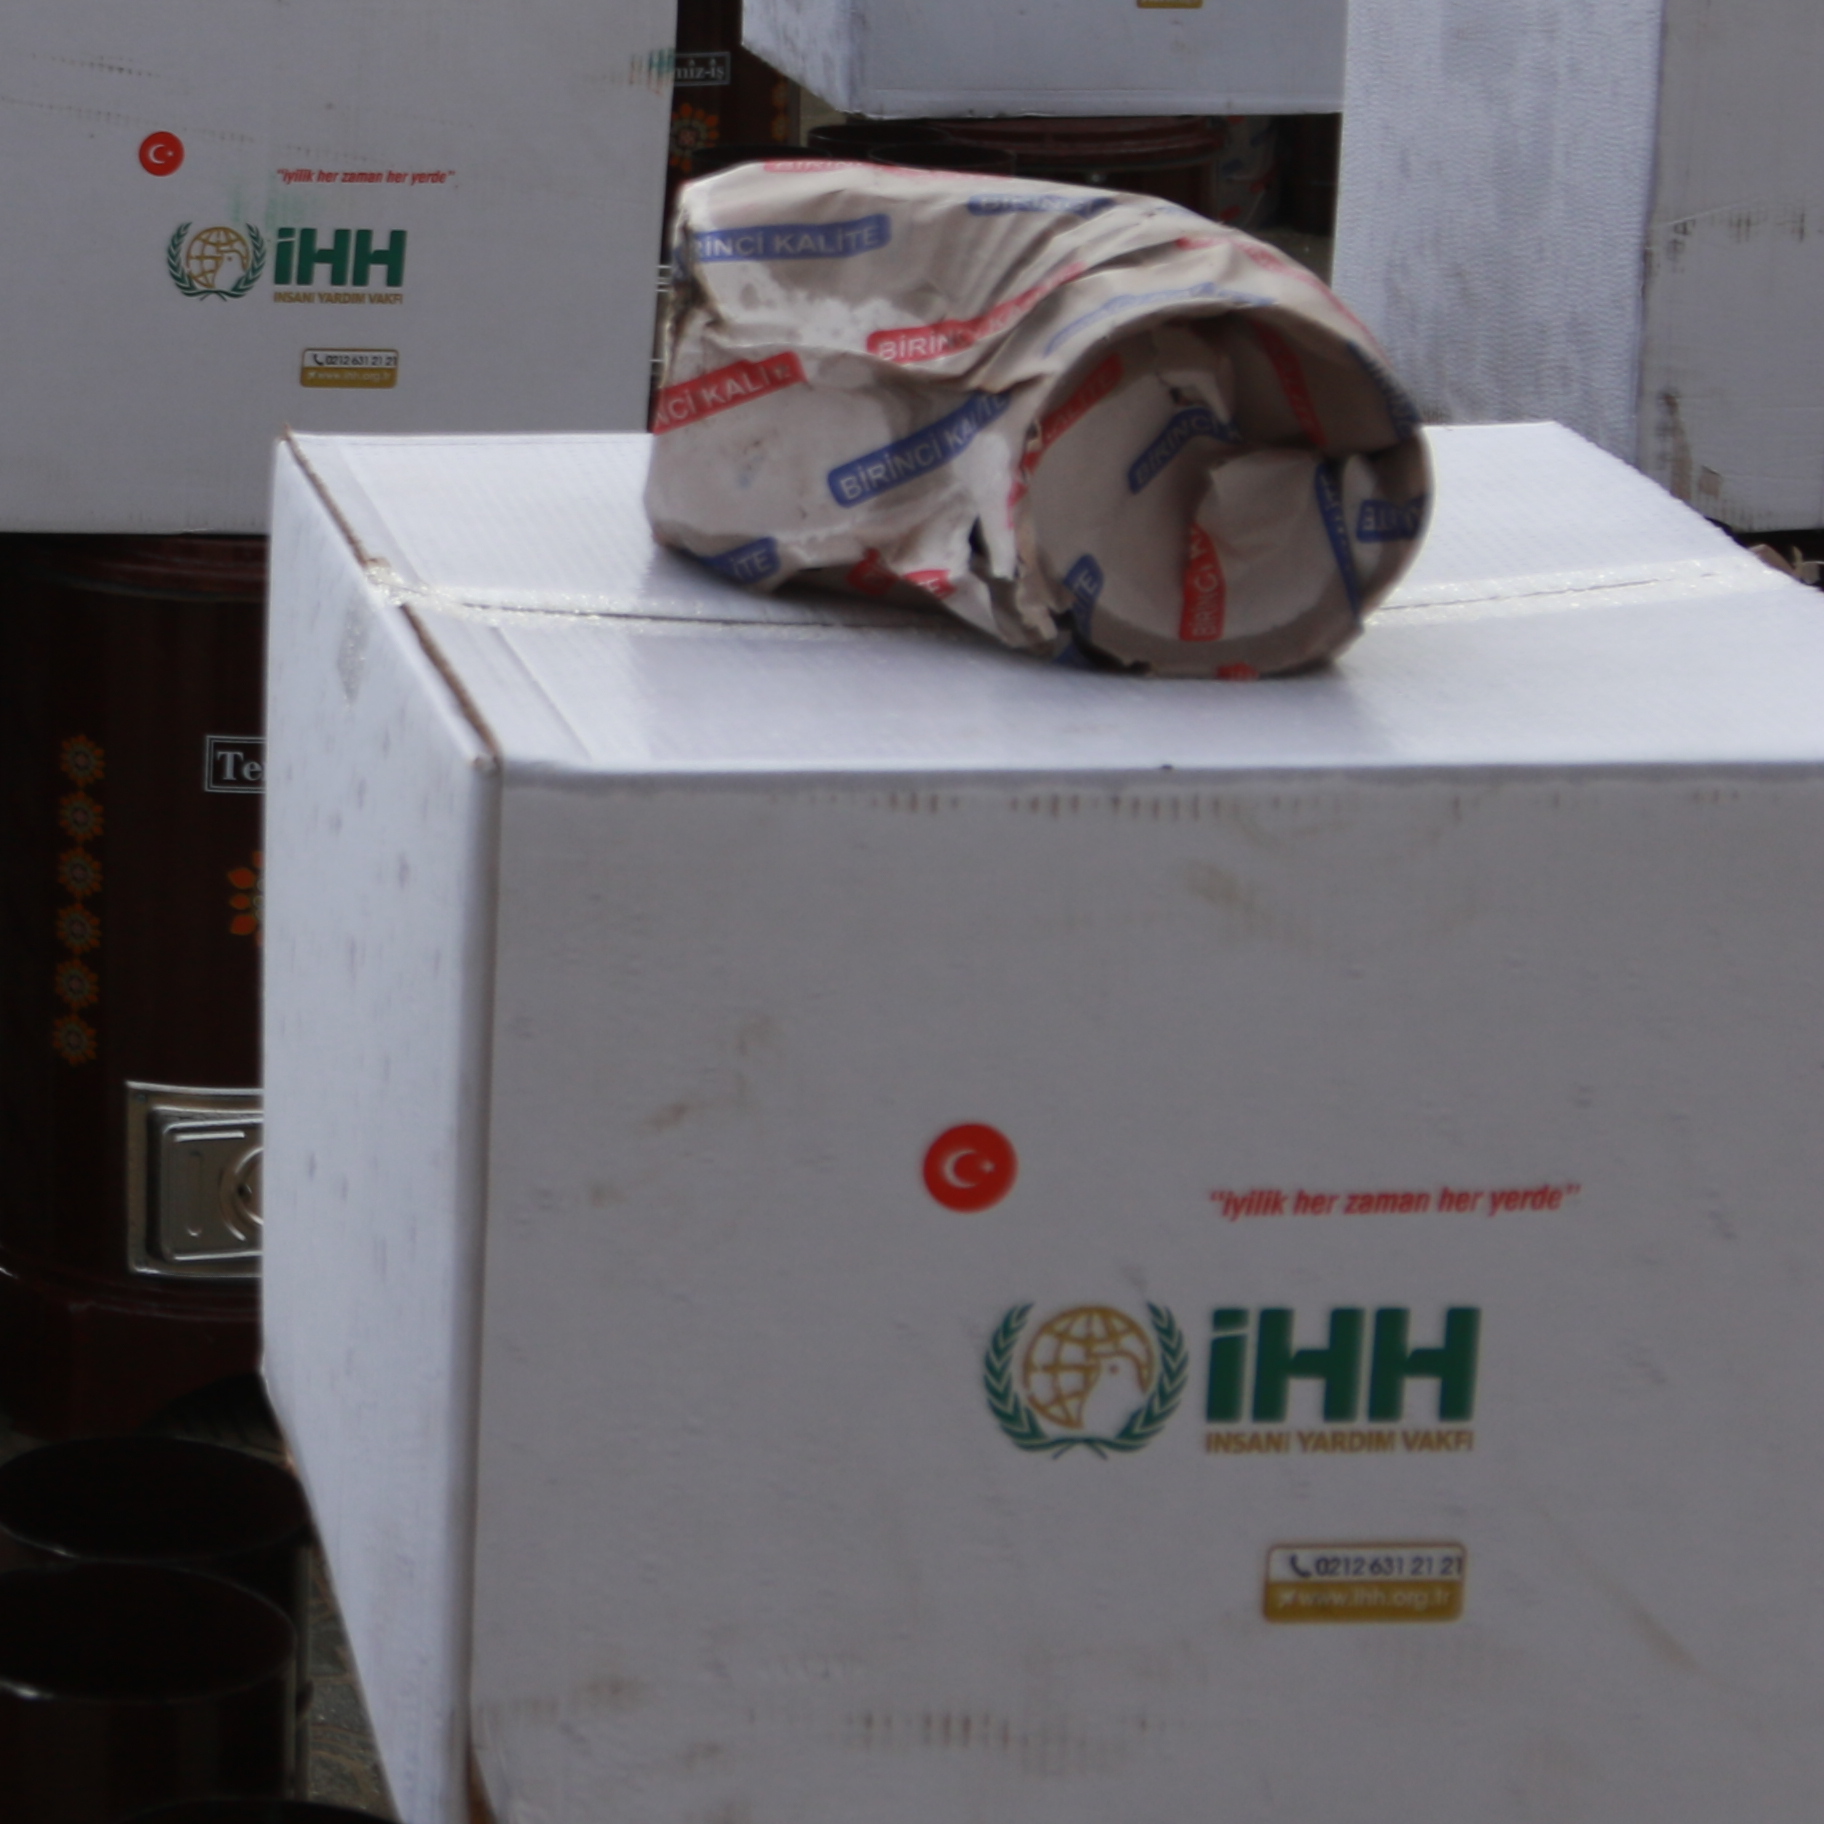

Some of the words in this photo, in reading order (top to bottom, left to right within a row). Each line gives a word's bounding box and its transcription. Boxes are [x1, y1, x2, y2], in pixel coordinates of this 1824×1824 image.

[317, 169, 339, 183] her
[342, 171, 382, 184] zaman
[387, 170, 408, 184] her
[774, 225, 881, 253] KALİTE
[838, 440, 942, 501] BİRİNCİ
[1292, 1190, 1337, 1216] her
[1344, 1192, 1428, 1215] zaman
[1438, 1188, 1480, 1214] her
[1298, 1431, 1394, 1454] YARDIM
[1402, 1431, 1474, 1452] VAKFI
[1314, 1555, 1366, 1577] 0212
[1370, 1554, 1404, 1577] 631
[1410, 1554, 1433, 1576] 21
[1438, 1554, 1463, 1576] 21
